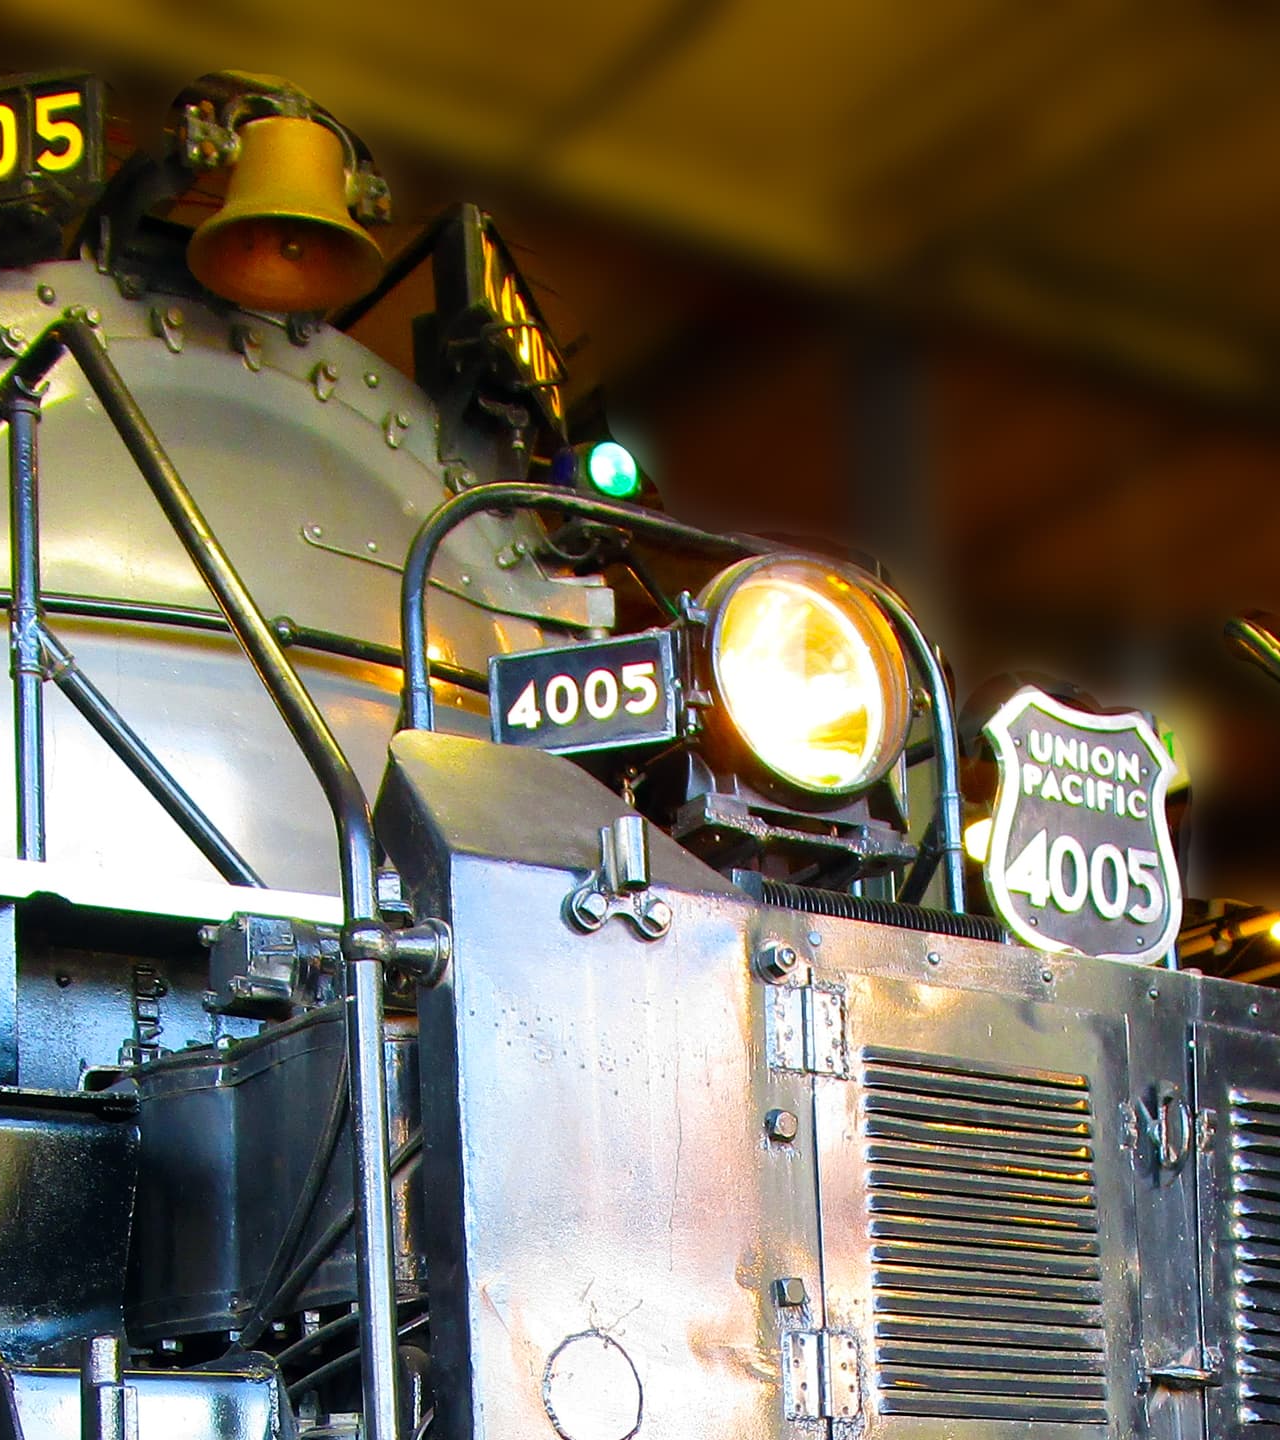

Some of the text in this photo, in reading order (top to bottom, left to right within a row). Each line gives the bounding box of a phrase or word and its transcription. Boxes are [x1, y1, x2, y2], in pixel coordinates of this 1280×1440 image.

[507, 660, 658, 730] 4005
[1028, 729, 1141, 785] UNION
[1022, 763, 1148, 820] PACIFIC
[1005, 828, 1164, 923] 4005
